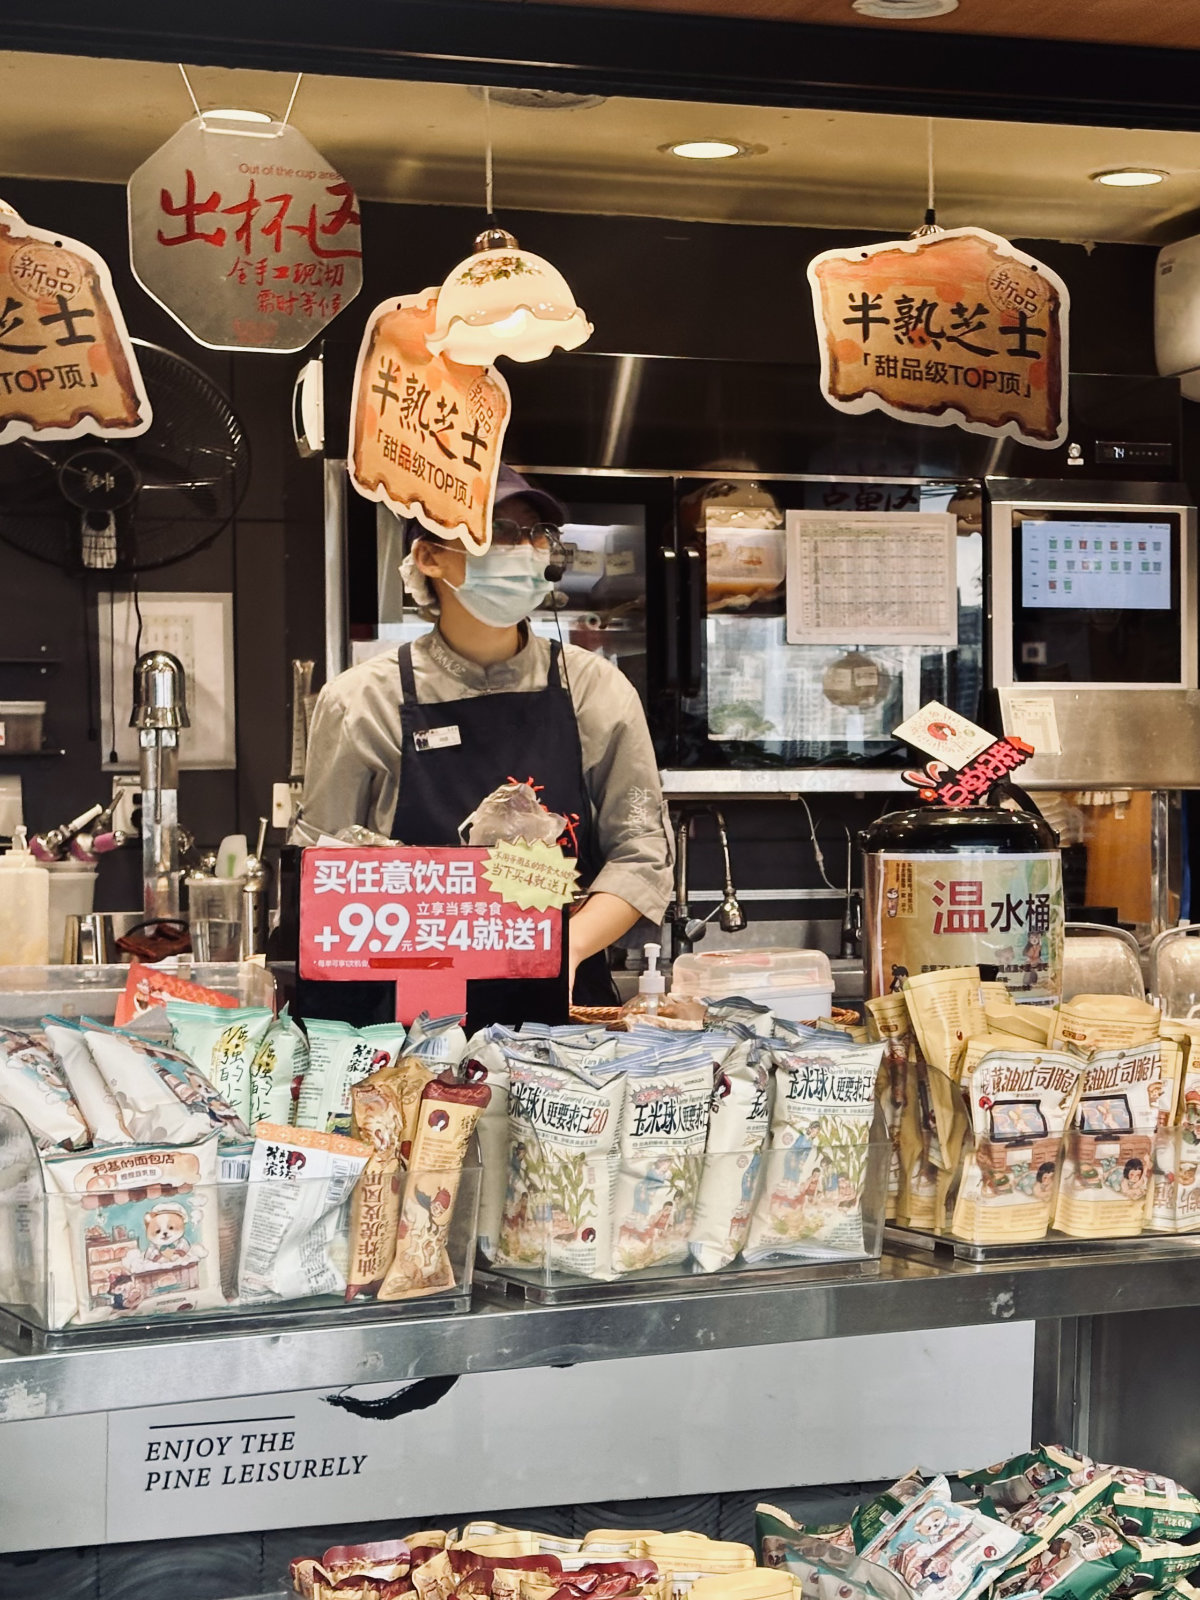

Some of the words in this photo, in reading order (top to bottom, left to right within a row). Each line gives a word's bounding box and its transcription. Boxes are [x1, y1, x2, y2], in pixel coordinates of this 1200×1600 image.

[239, 163, 259, 175] Out
[262, 166, 273, 175] of
[276, 166, 294, 177] the
[296, 170, 316, 180] cup
[158, 168, 362, 258] 出杯区
[14, 254, 76, 294] 新品
[988, 269, 1038, 314] 新品
[256, 289, 343, 319] 需时等候
[842, 291, 1047, 360] 半熟芝士
[371, 355, 488, 472] 半熟芝士
[313, 860, 476, 894] 买任意饮品
[416, 902, 502, 916] 立享当季零食
[930, 879, 1050, 935] 温水桶
[415, 917, 552, 951] 买4就送1
[92, 1153, 175, 1175] 柯基的面包店
[144, 1435, 232, 1463] ENJOY
[239, 1431, 297, 1454] THE
[144, 1466, 212, 1492] PINE
[221, 1454, 369, 1486] LEISURELY
